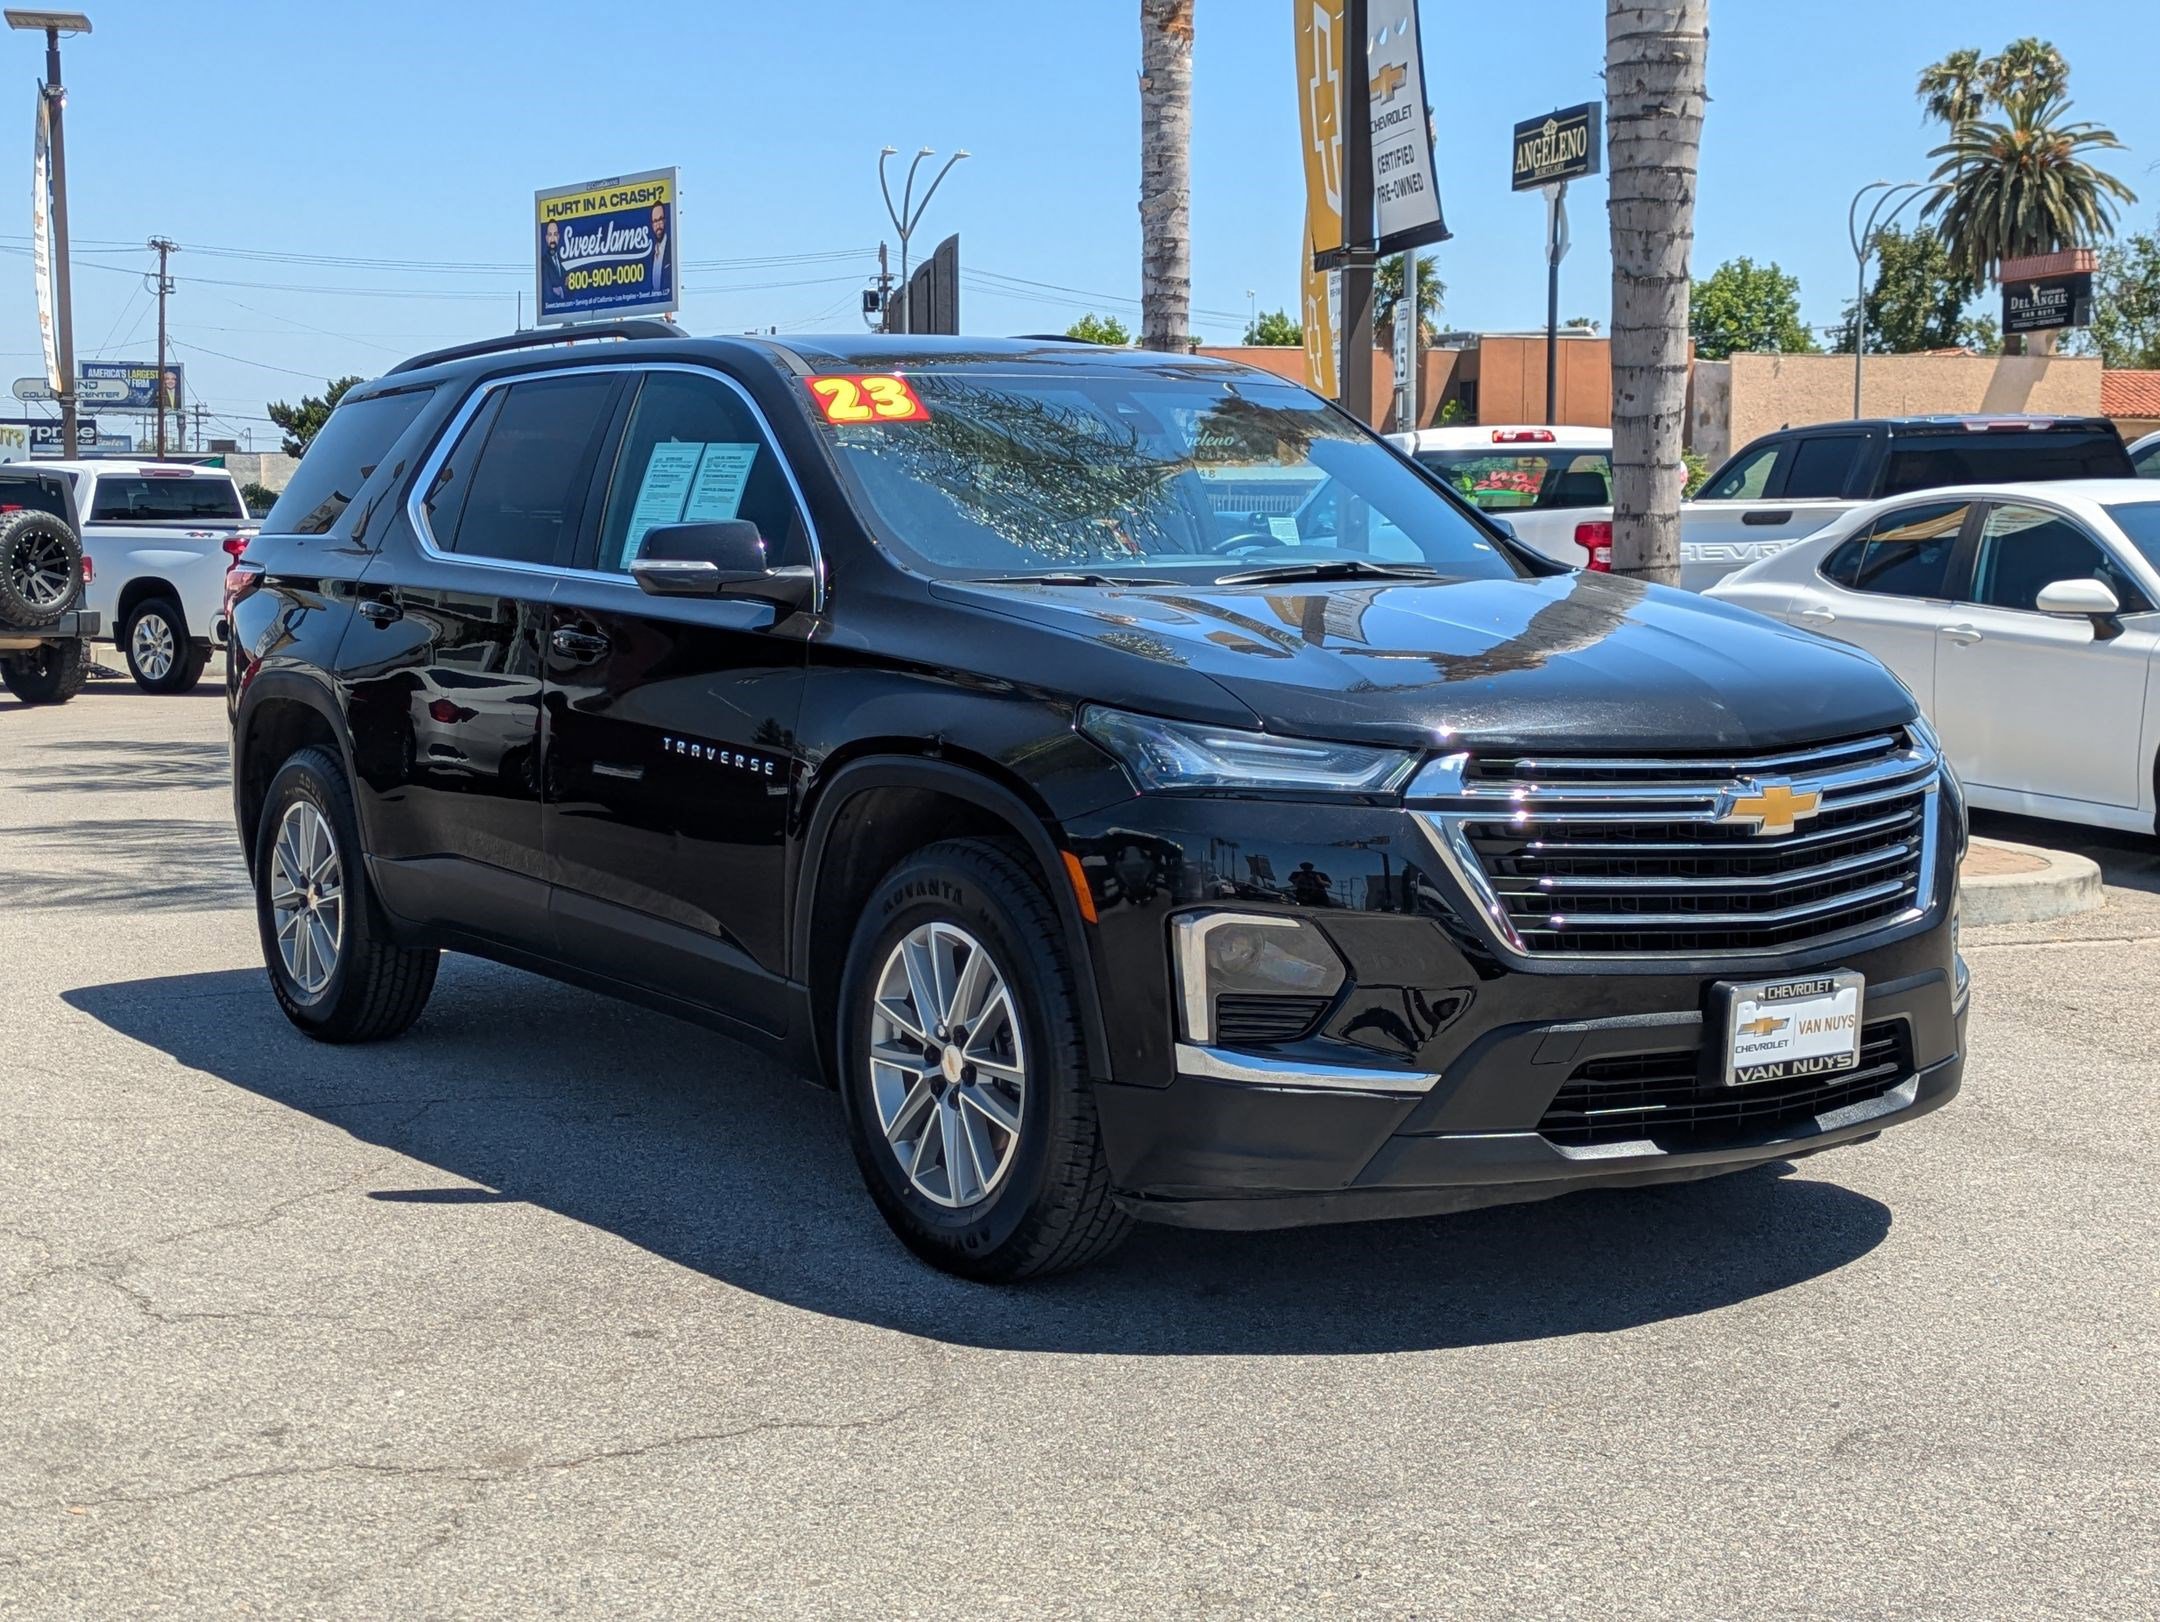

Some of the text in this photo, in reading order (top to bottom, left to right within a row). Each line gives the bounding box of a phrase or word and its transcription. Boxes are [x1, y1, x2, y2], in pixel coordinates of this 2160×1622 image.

[1370, 104, 1412, 134] CHEVROLET
[1377, 144, 1415, 175] CERTIFIED
[1515, 125, 1587, 174] ANGELENO
[546, 186, 665, 217] HURT IN A CRASH?
[1377, 172, 1424, 206] PRE-OWNED
[568, 263, 645, 290] 800-900-0000
[2010, 293, 2067, 310] DEL ANGEL
[88, 368, 159, 380] AMERICA'S LARGEST
[132, 379, 150, 388] FIRM
[812, 377, 917, 420] 23
[663, 737, 774, 775] TRAVERSE
[1767, 980, 1831, 999] CHEVROLET
[1799, 1015, 1855, 1035] VAN NUYS
[1735, 1040, 1789, 1054] CHEVROLET
[1737, 1054, 1853, 1082] VAN NUYS
